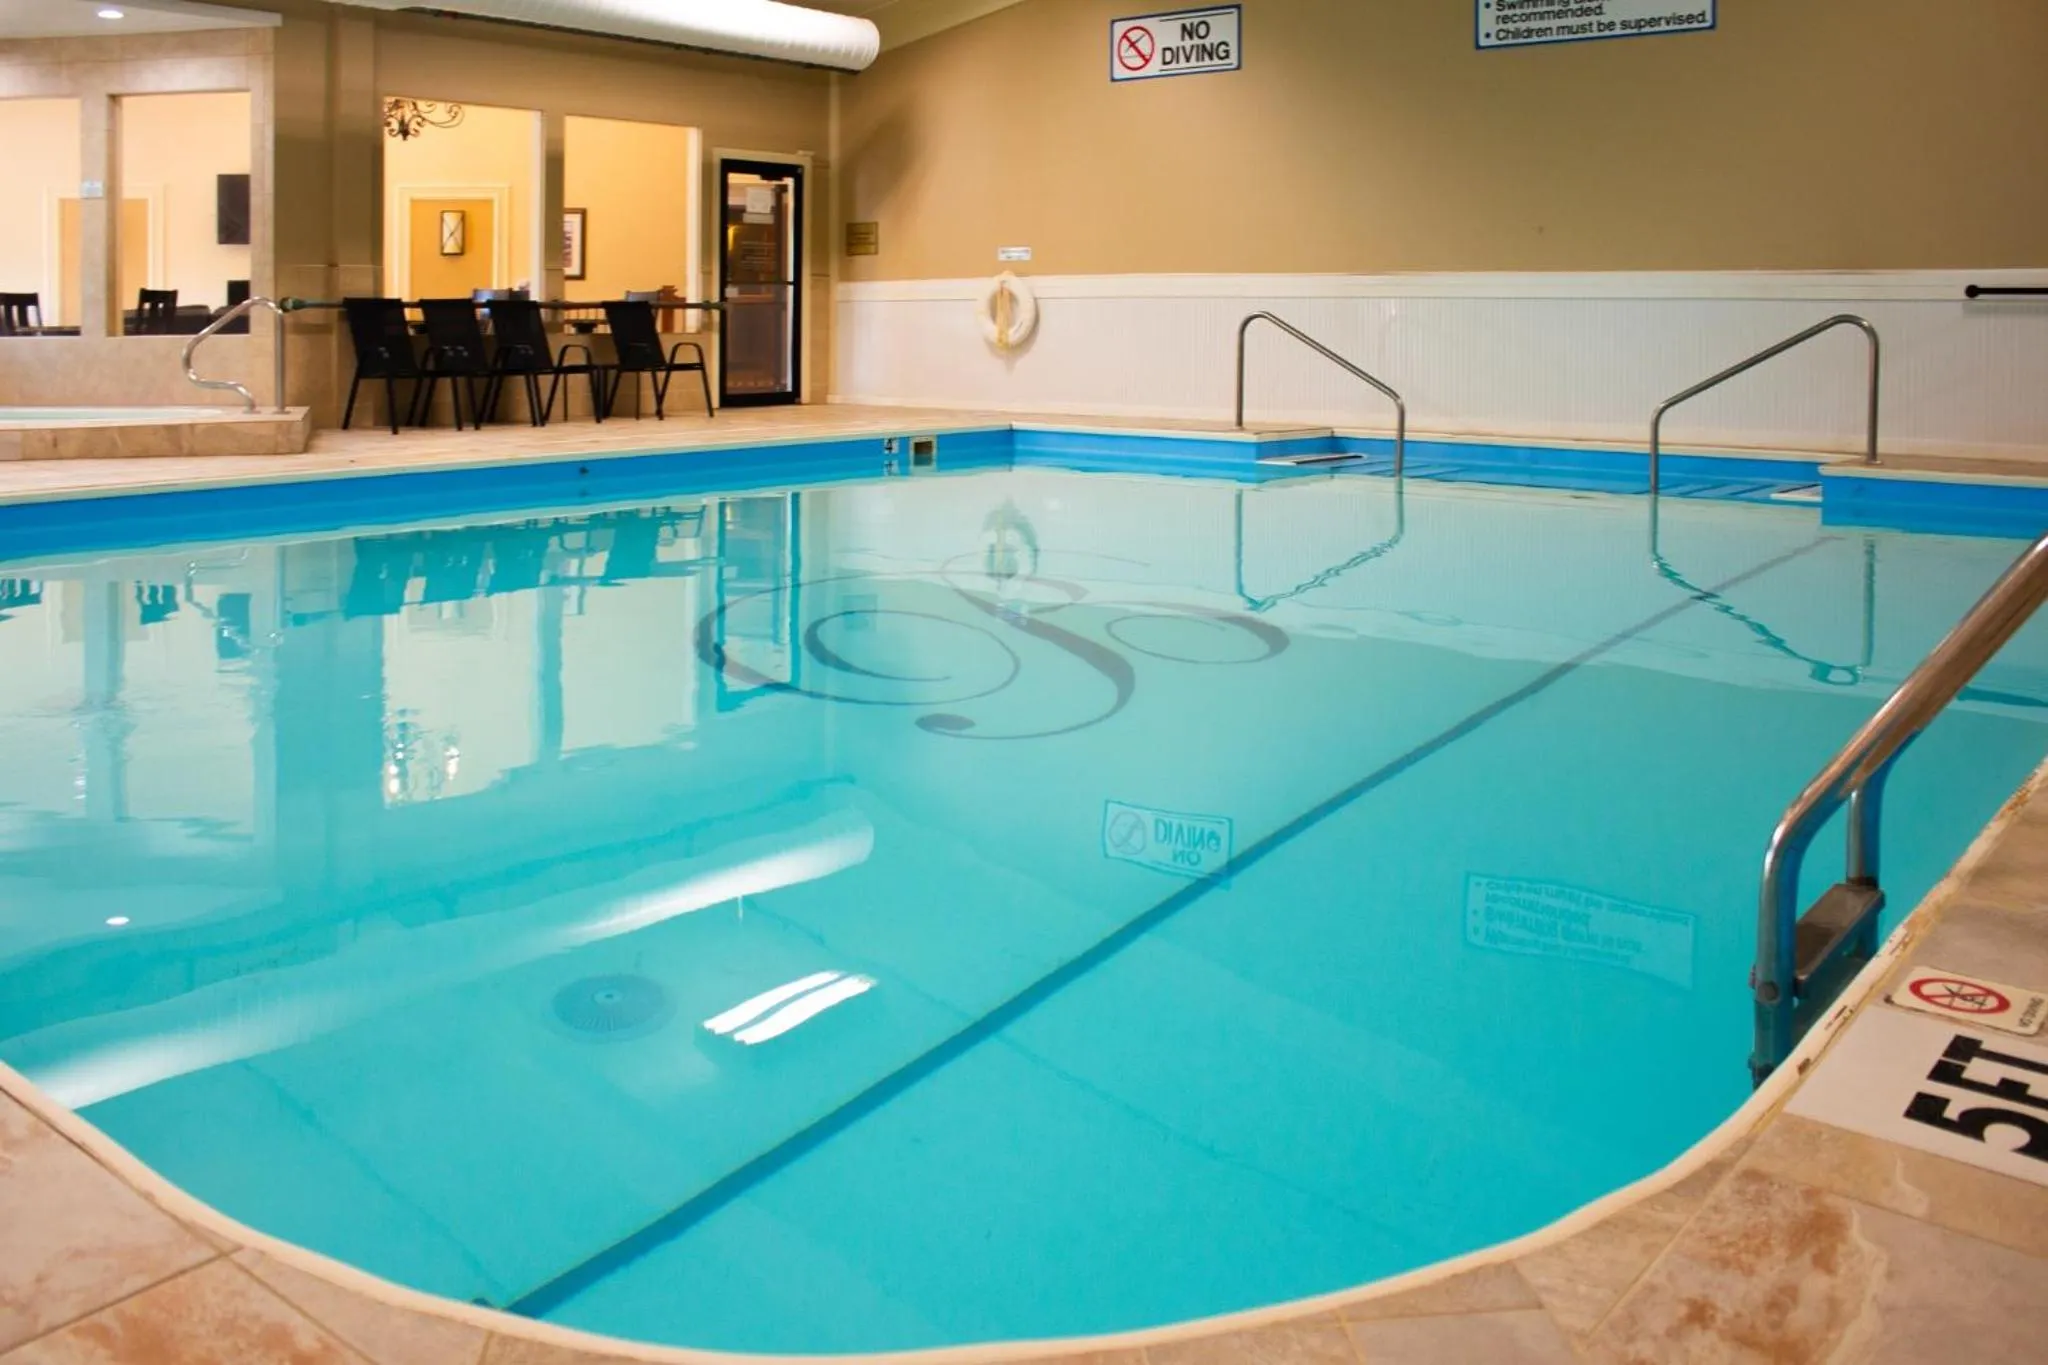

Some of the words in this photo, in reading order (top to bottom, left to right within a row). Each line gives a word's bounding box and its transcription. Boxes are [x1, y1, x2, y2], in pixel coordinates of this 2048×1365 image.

[1495, 3, 1606, 25] recommended.
[1180, 20, 1210, 42] NO
[1495, 26, 1553, 41] Children
[1556, 21, 1594, 35] must
[1597, 20, 1616, 32] be
[1161, 41, 1230, 65] DIVING
